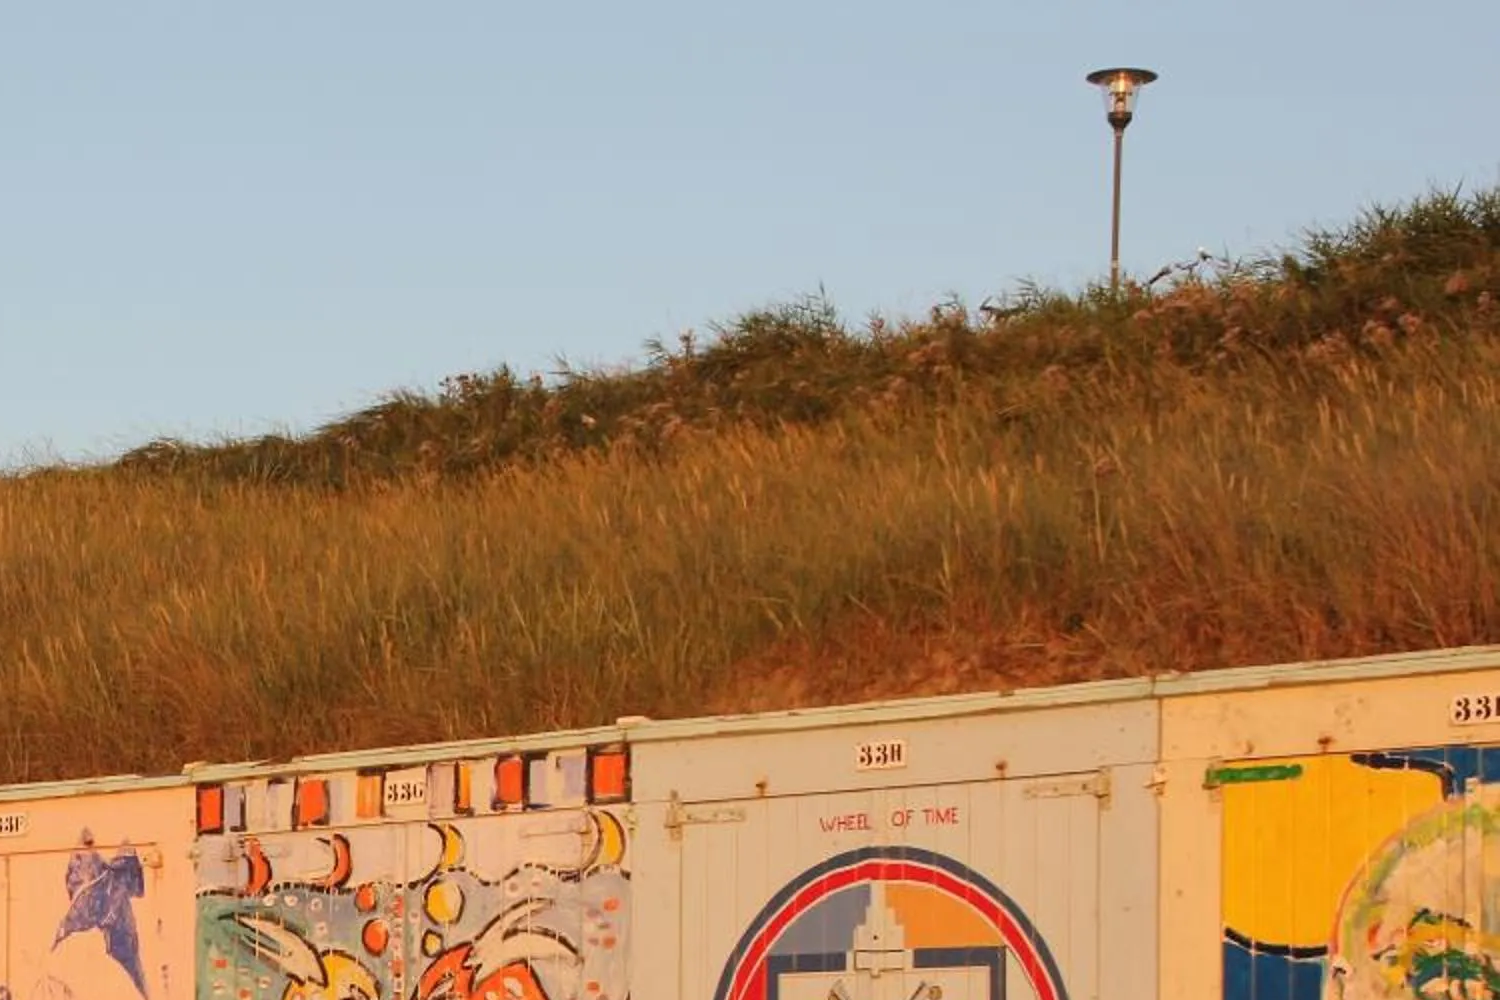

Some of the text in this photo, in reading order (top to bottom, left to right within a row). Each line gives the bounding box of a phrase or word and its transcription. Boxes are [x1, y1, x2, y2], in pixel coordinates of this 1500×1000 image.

[859, 743, 902, 765] 33H
[819, 807, 959, 832] WHEEL OF TIME
